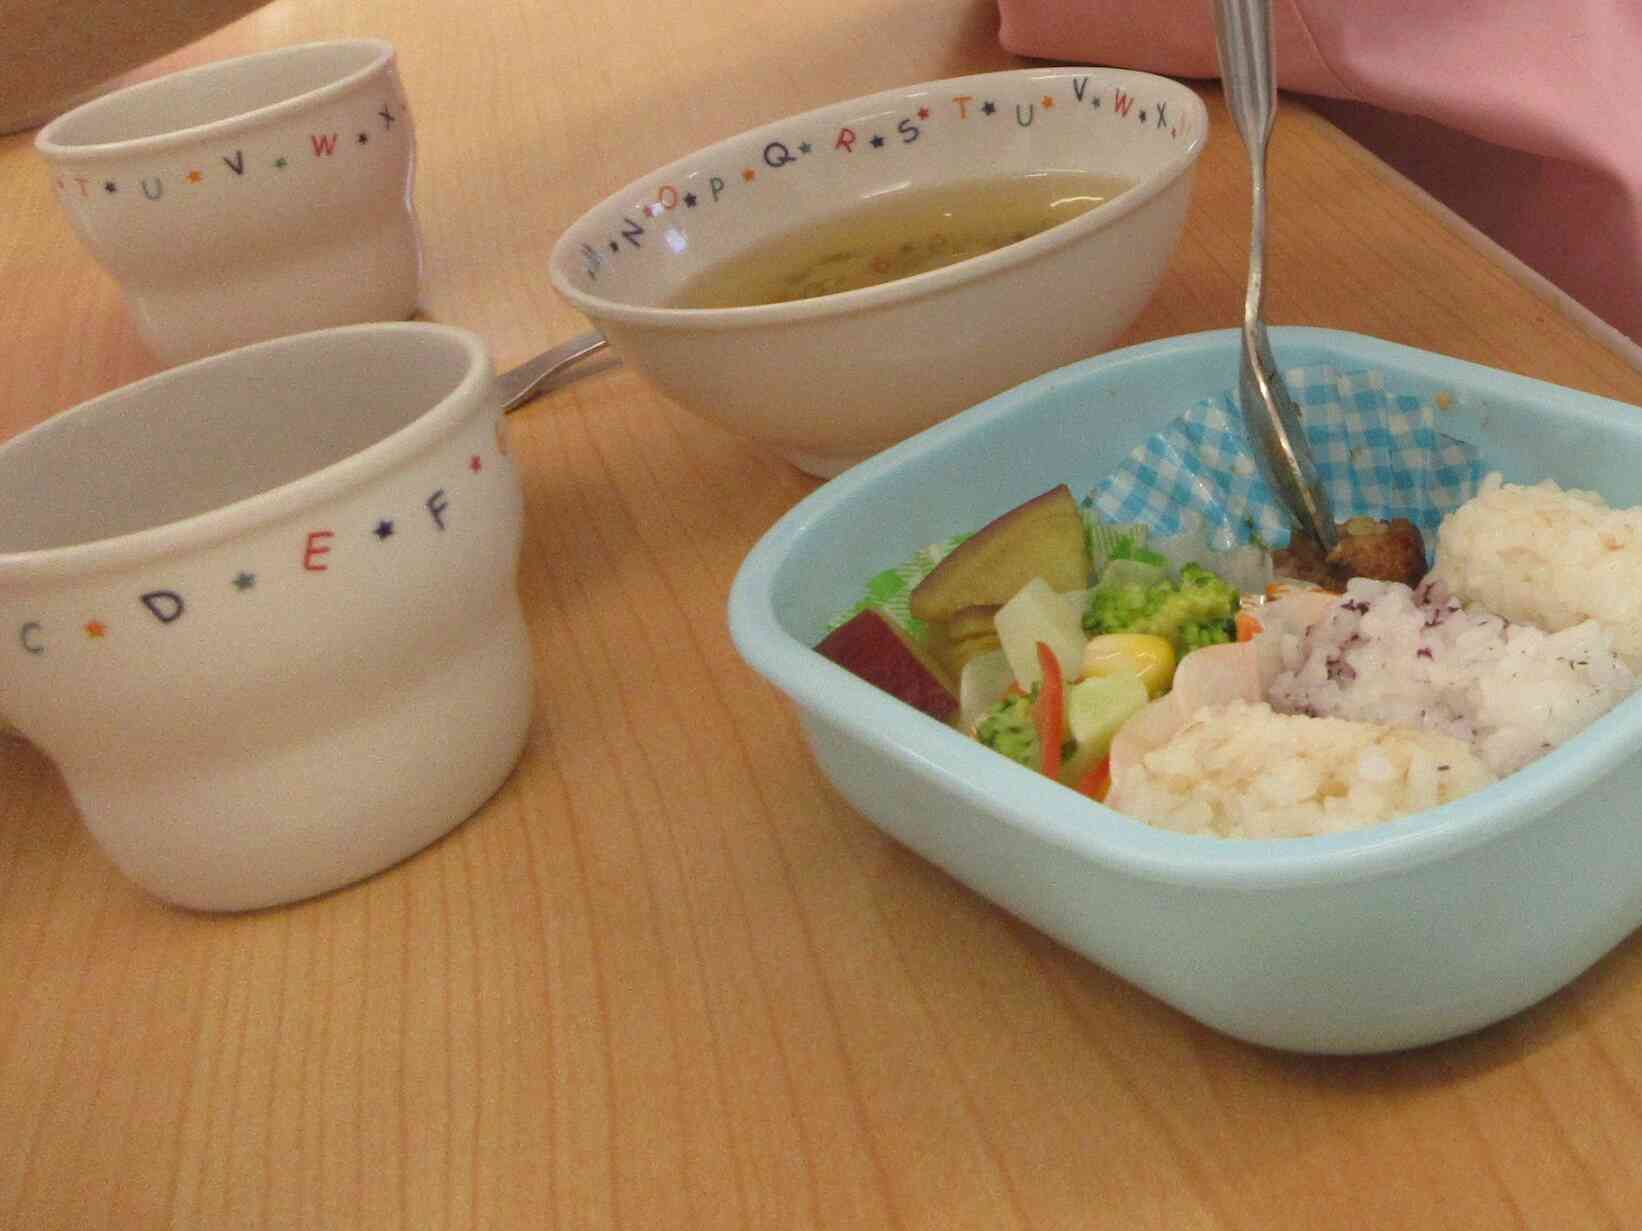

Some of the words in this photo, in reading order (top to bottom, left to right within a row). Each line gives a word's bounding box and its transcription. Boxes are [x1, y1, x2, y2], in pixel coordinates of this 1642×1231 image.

[141, 176, 163, 201] U
[223, 150, 245, 176] V
[311, 133, 338, 157] W
[709, 176, 725, 203] P
[763, 142, 797, 168] Q
[834, 128, 857, 152] R
[899, 118, 921, 144] S
[952, 96, 975, 120] T
[1016, 103, 1035, 128] U
[1072, 77, 1088, 102] V
[1114, 87, 1134, 118] W
[1156, 101, 1167, 128] X
[20, 621, 44, 655] C
[139, 588, 186, 623] D
[302, 529, 335, 572] E
[425, 488, 449, 532] F
